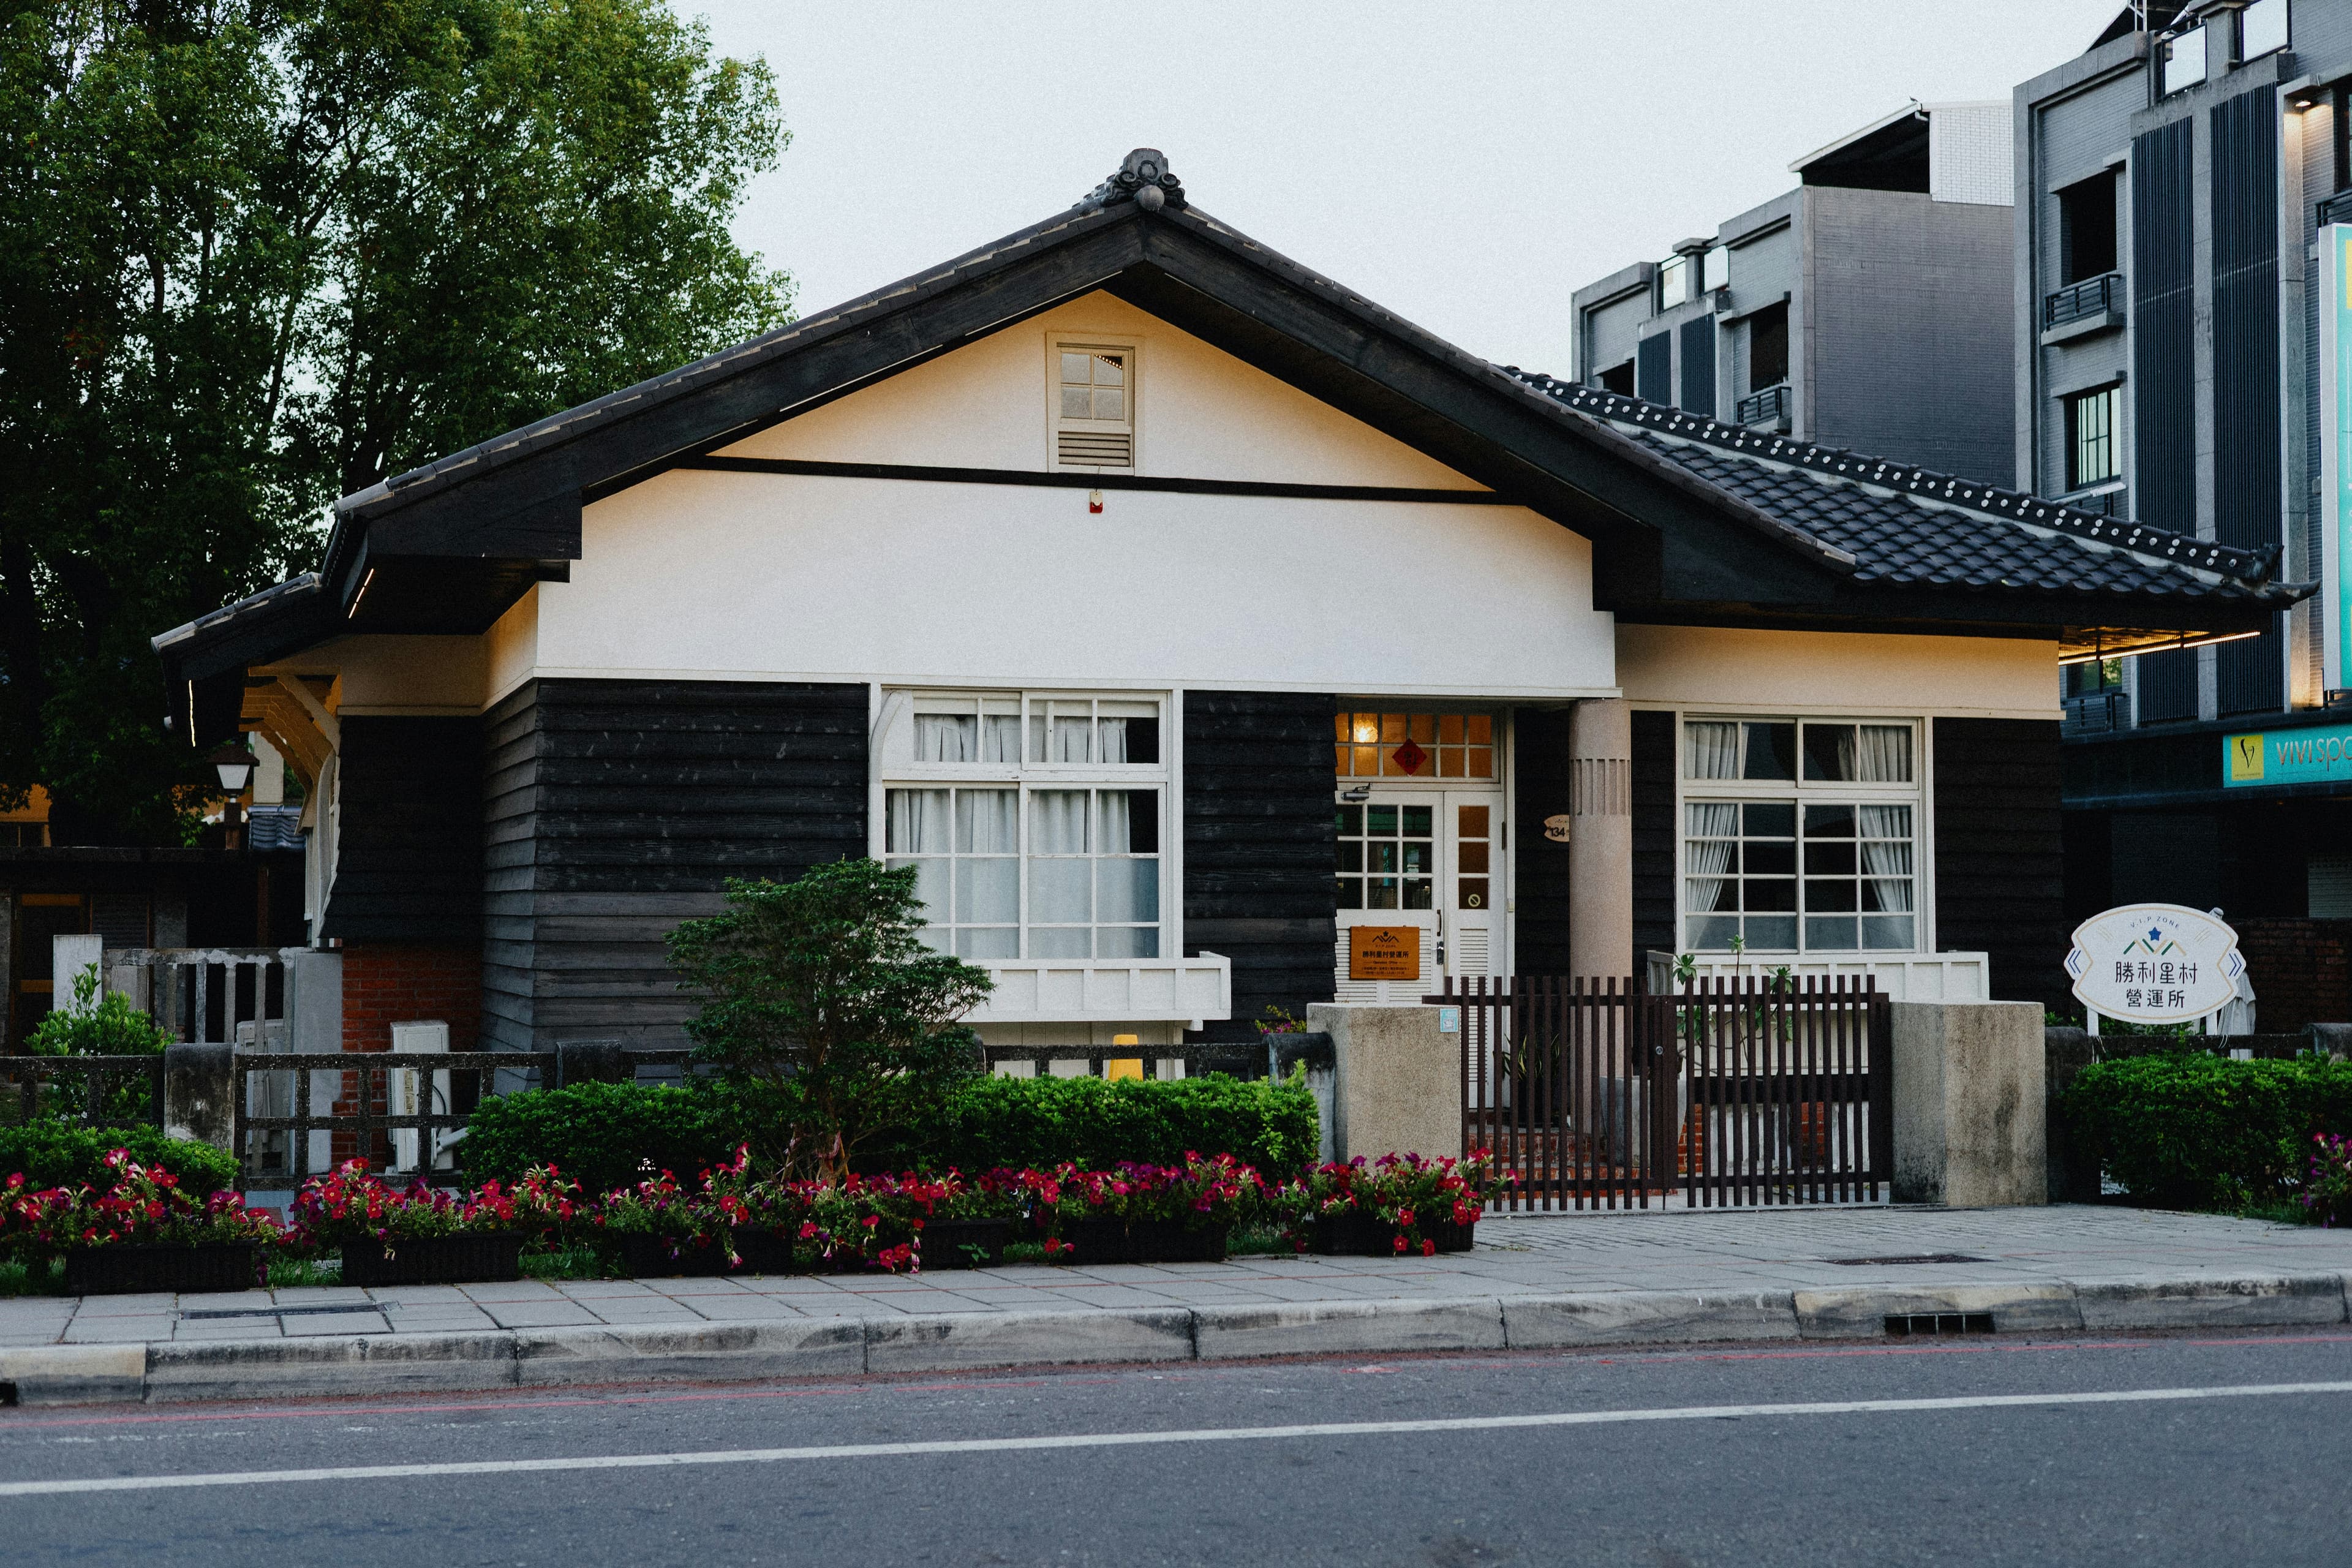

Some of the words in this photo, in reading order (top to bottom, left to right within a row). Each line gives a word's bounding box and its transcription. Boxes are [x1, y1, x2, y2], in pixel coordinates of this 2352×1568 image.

[1550, 827, 1566, 837] 134
[2157, 916, 2179, 929] ZONE
[2126, 989, 2185, 1008] 營運所
